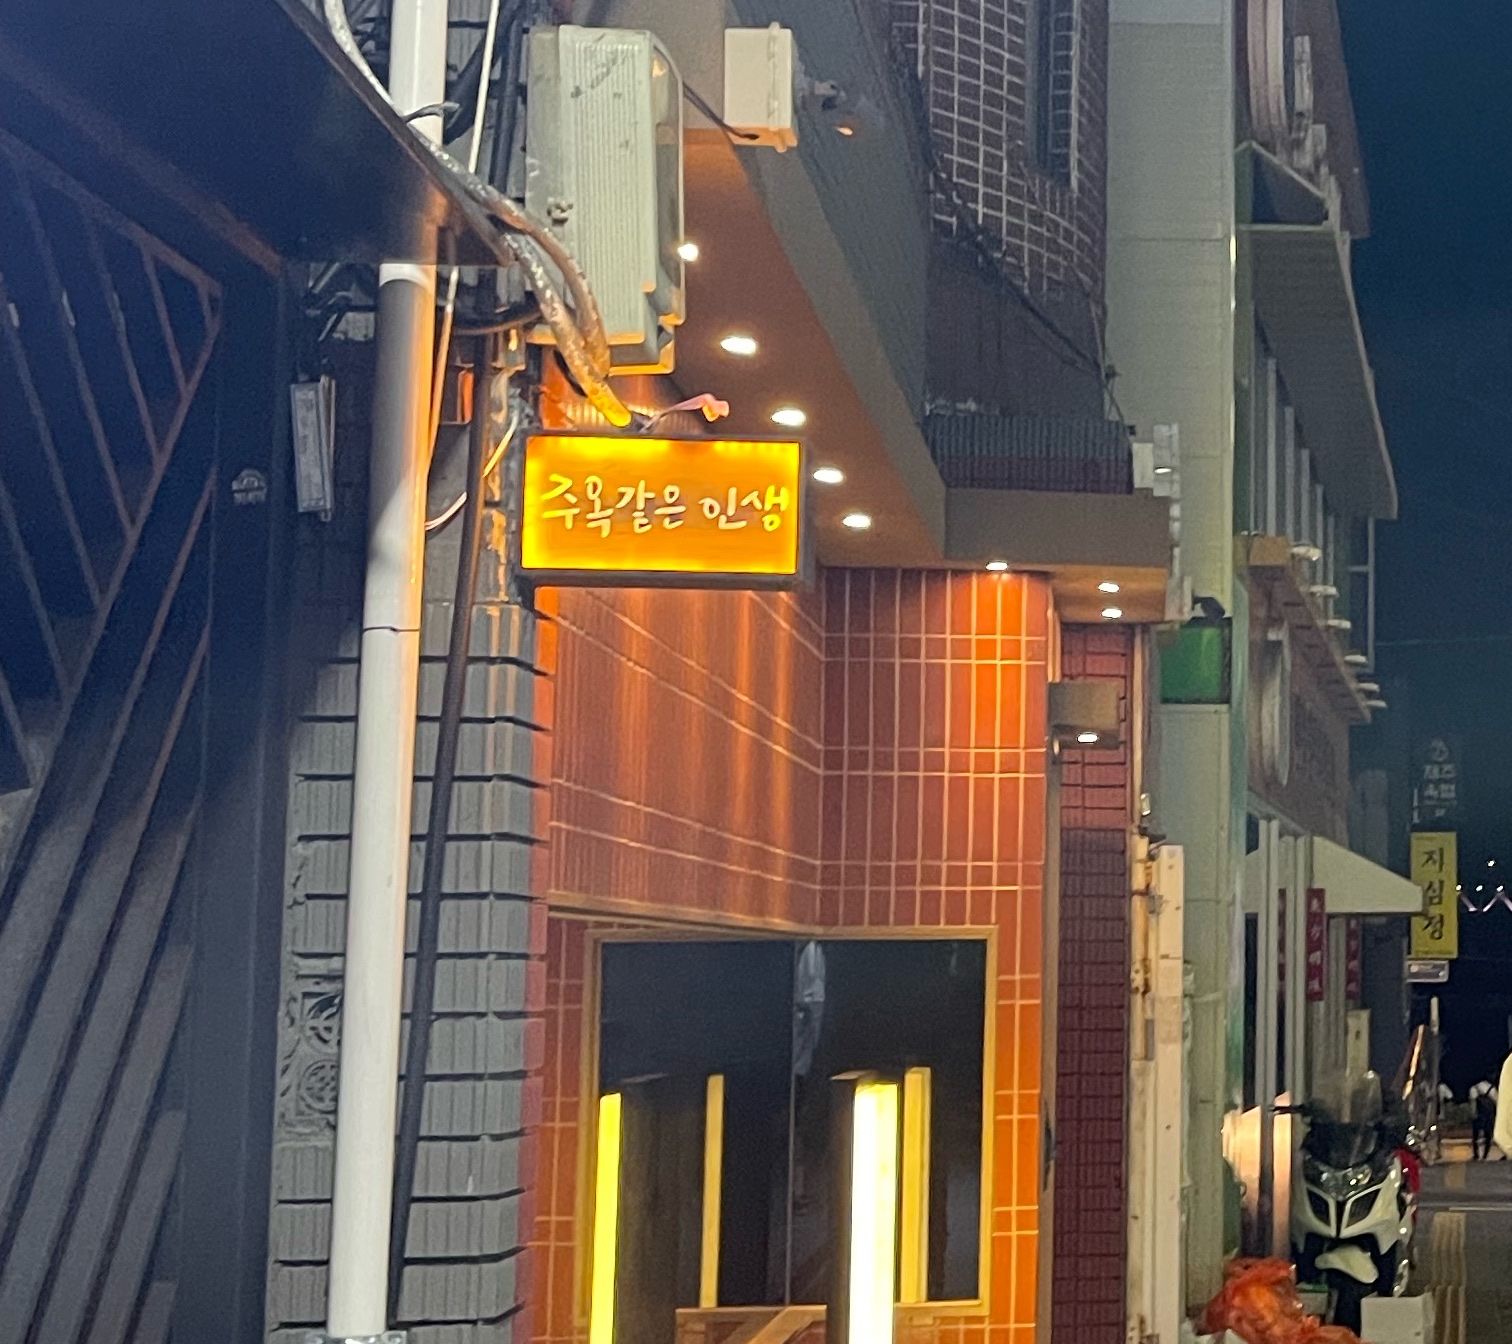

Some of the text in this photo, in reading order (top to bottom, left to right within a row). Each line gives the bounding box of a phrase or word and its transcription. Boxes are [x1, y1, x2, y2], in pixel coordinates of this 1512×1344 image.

[541, 474, 790, 538] 주옥같은 인생
[1421, 847, 1445, 940] 지심정
